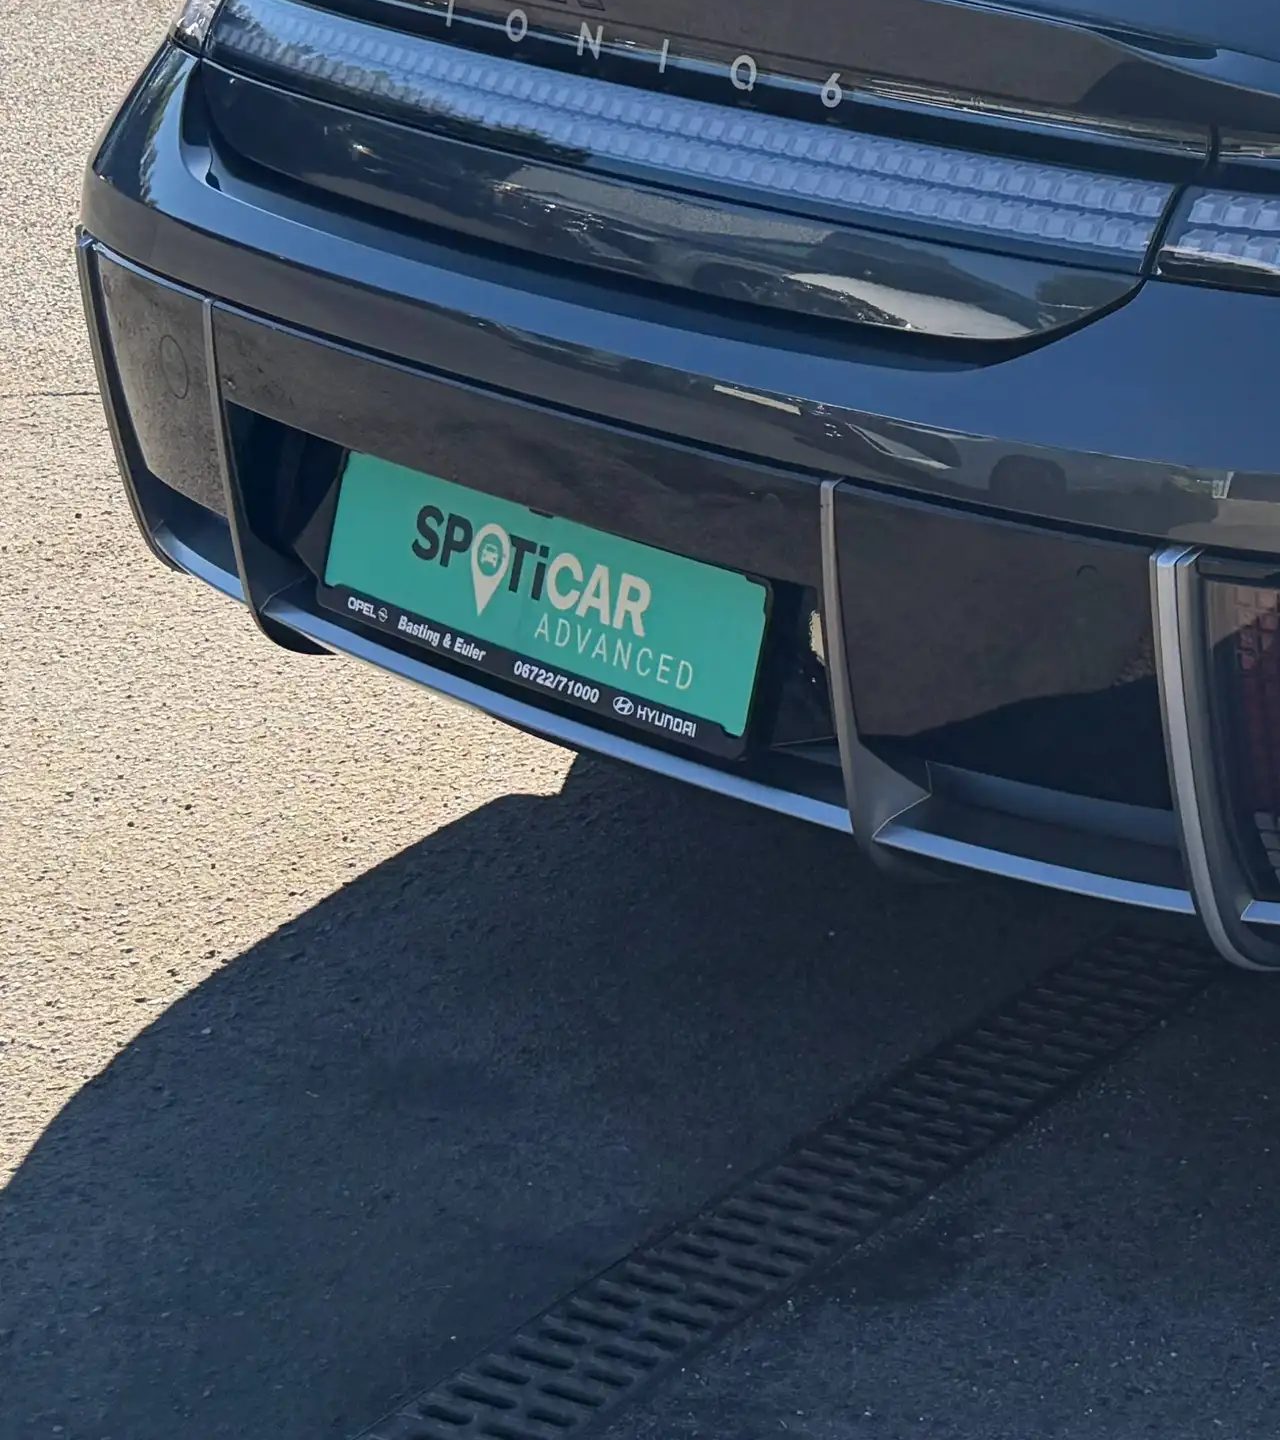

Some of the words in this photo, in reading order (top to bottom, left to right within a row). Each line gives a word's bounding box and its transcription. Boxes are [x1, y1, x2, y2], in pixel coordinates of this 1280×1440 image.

[820, 72, 843, 108] 6
[347, 596, 377, 619] OPEL
[397, 615, 441, 647] Basting
[442, 632, 453, 650] &
[453, 638, 487, 662] Euler
[513, 660, 600, 704] 06722/71000
[636, 704, 697, 738] HYUNDAI
[534, 612, 694, 691] ADVANCED
